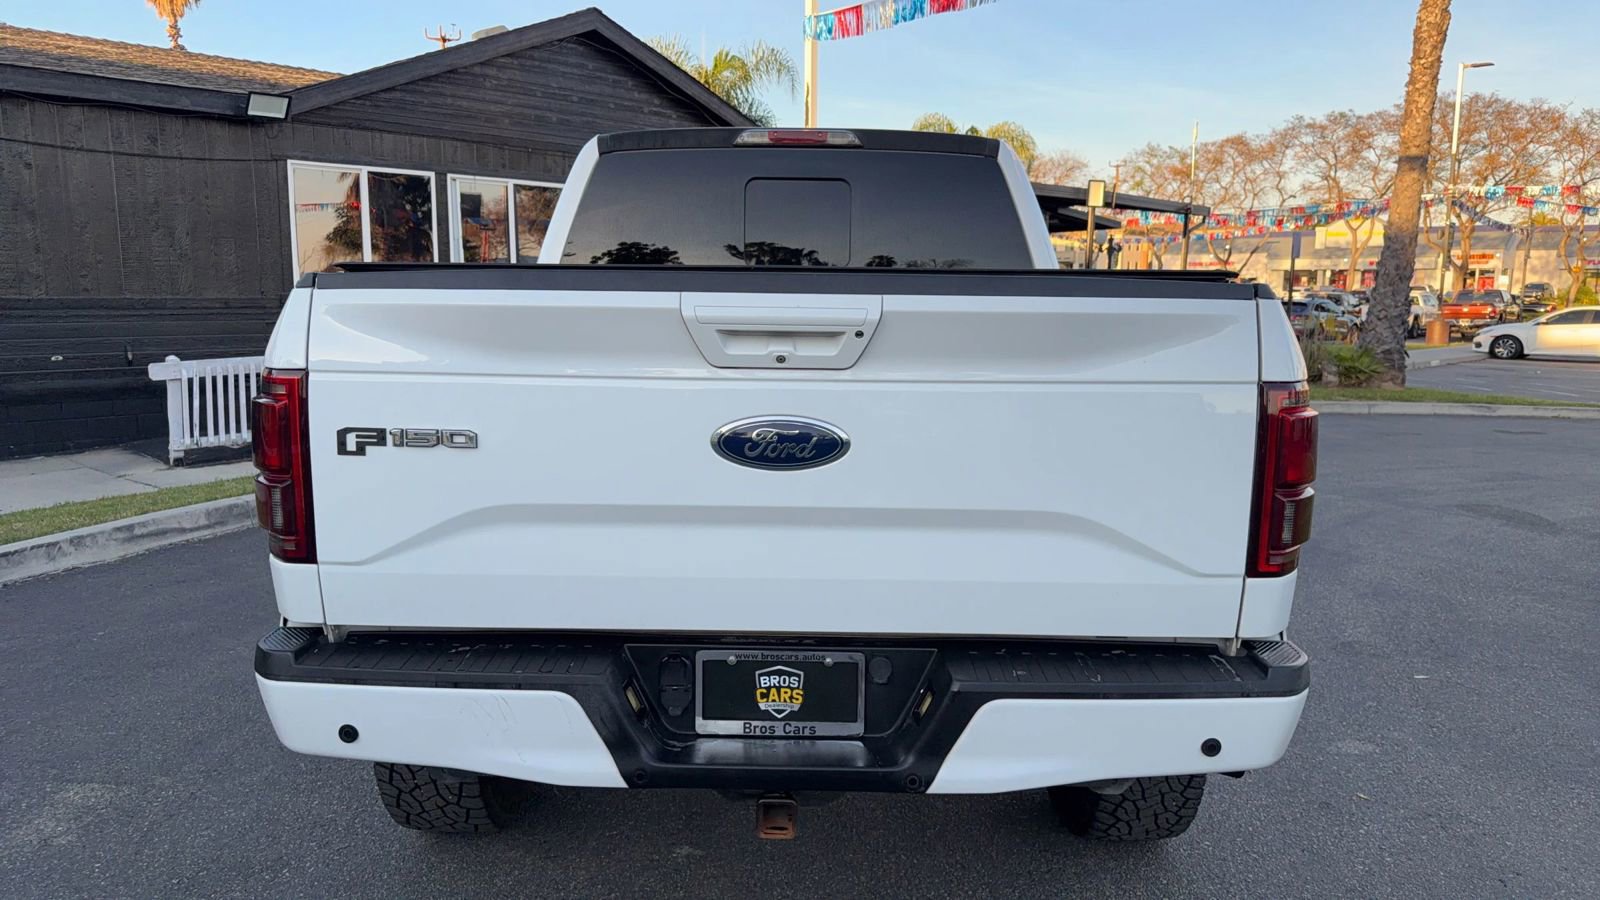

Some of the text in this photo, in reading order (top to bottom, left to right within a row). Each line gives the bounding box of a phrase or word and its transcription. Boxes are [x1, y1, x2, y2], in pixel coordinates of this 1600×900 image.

[744, 427, 819, 459] Ford
[735, 652, 826, 661] www.broscars.autos
[760, 675, 799, 687] BROS
[755, 688, 804, 704] CARS
[764, 702, 795, 710] Dealership
[743, 722, 817, 735] Bros Cars
